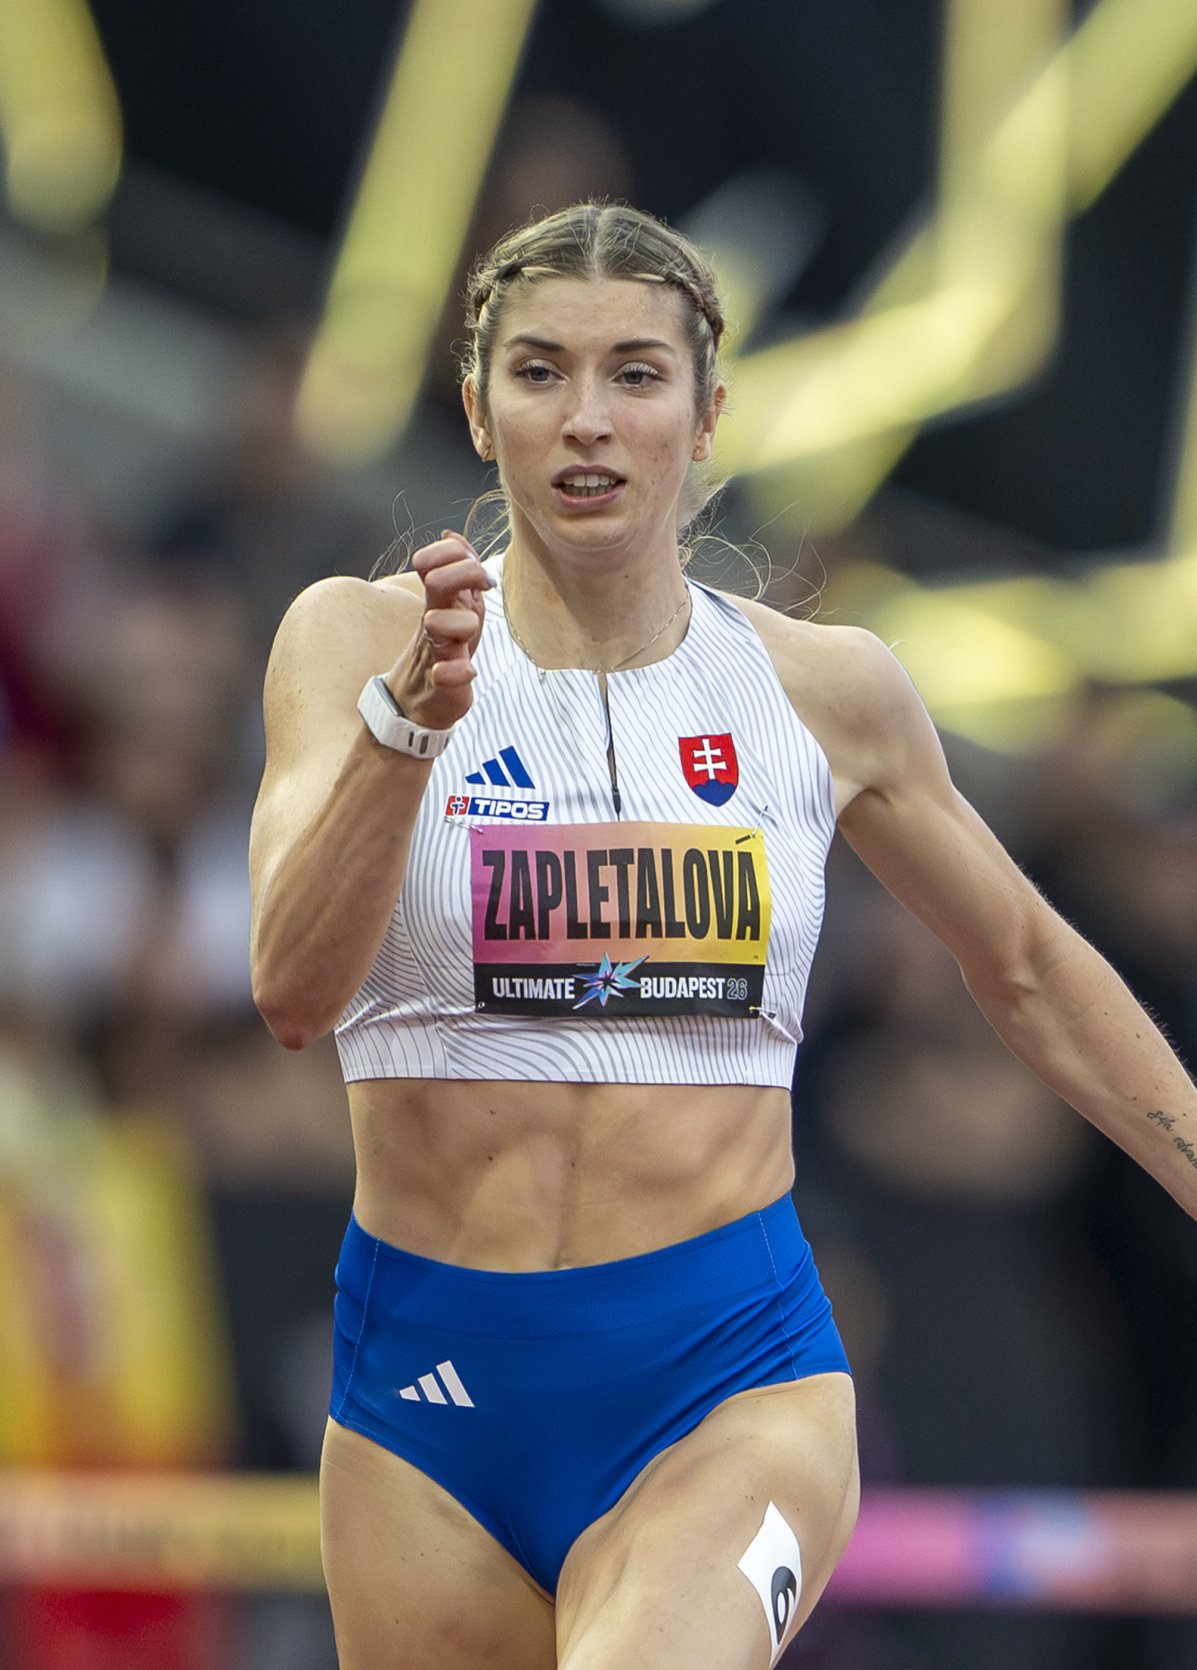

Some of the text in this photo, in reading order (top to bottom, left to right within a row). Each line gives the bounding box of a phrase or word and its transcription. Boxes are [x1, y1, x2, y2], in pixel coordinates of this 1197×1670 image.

[474, 798, 545, 820] TIPOS
[482, 834, 761, 941] ZAPLETALOVÁ
[492, 977, 749, 1000] ULTIMATE BUDAPEST 26
